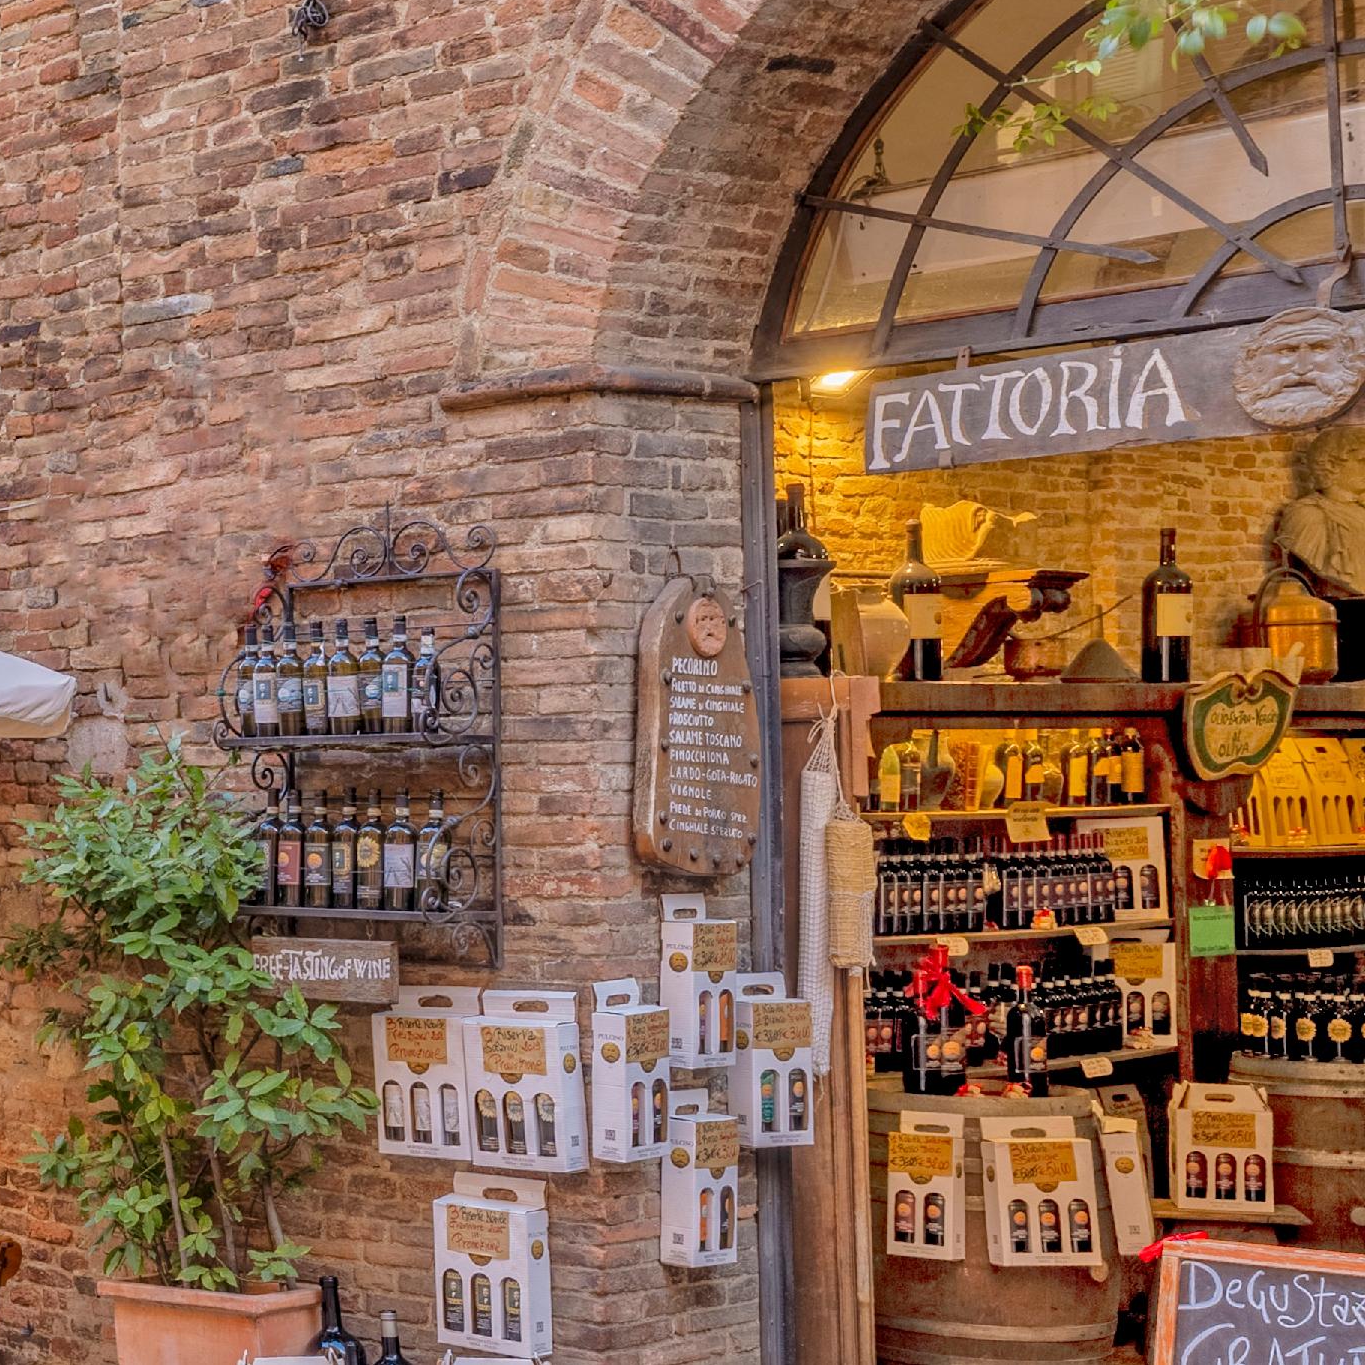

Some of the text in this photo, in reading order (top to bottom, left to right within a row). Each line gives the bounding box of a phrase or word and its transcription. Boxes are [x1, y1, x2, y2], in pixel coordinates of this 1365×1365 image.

[869, 346, 1186, 470] FATTORIA
[671, 657, 718, 676] PECORINO
[669, 696, 697, 710] SALAME
[705, 699, 745, 714] CINGHIALE
[669, 712, 714, 727] PROSCIUTTO
[669, 730, 742, 748] SALAME TOSCANO
[669, 749, 730, 765] FINOCCHIONA
[669, 783, 712, 800] VIGNOLE
[669, 801, 691, 816] PIEDE
[669, 818, 709, 835] CINGHIALE
[354, 957, 391, 980] WINE
